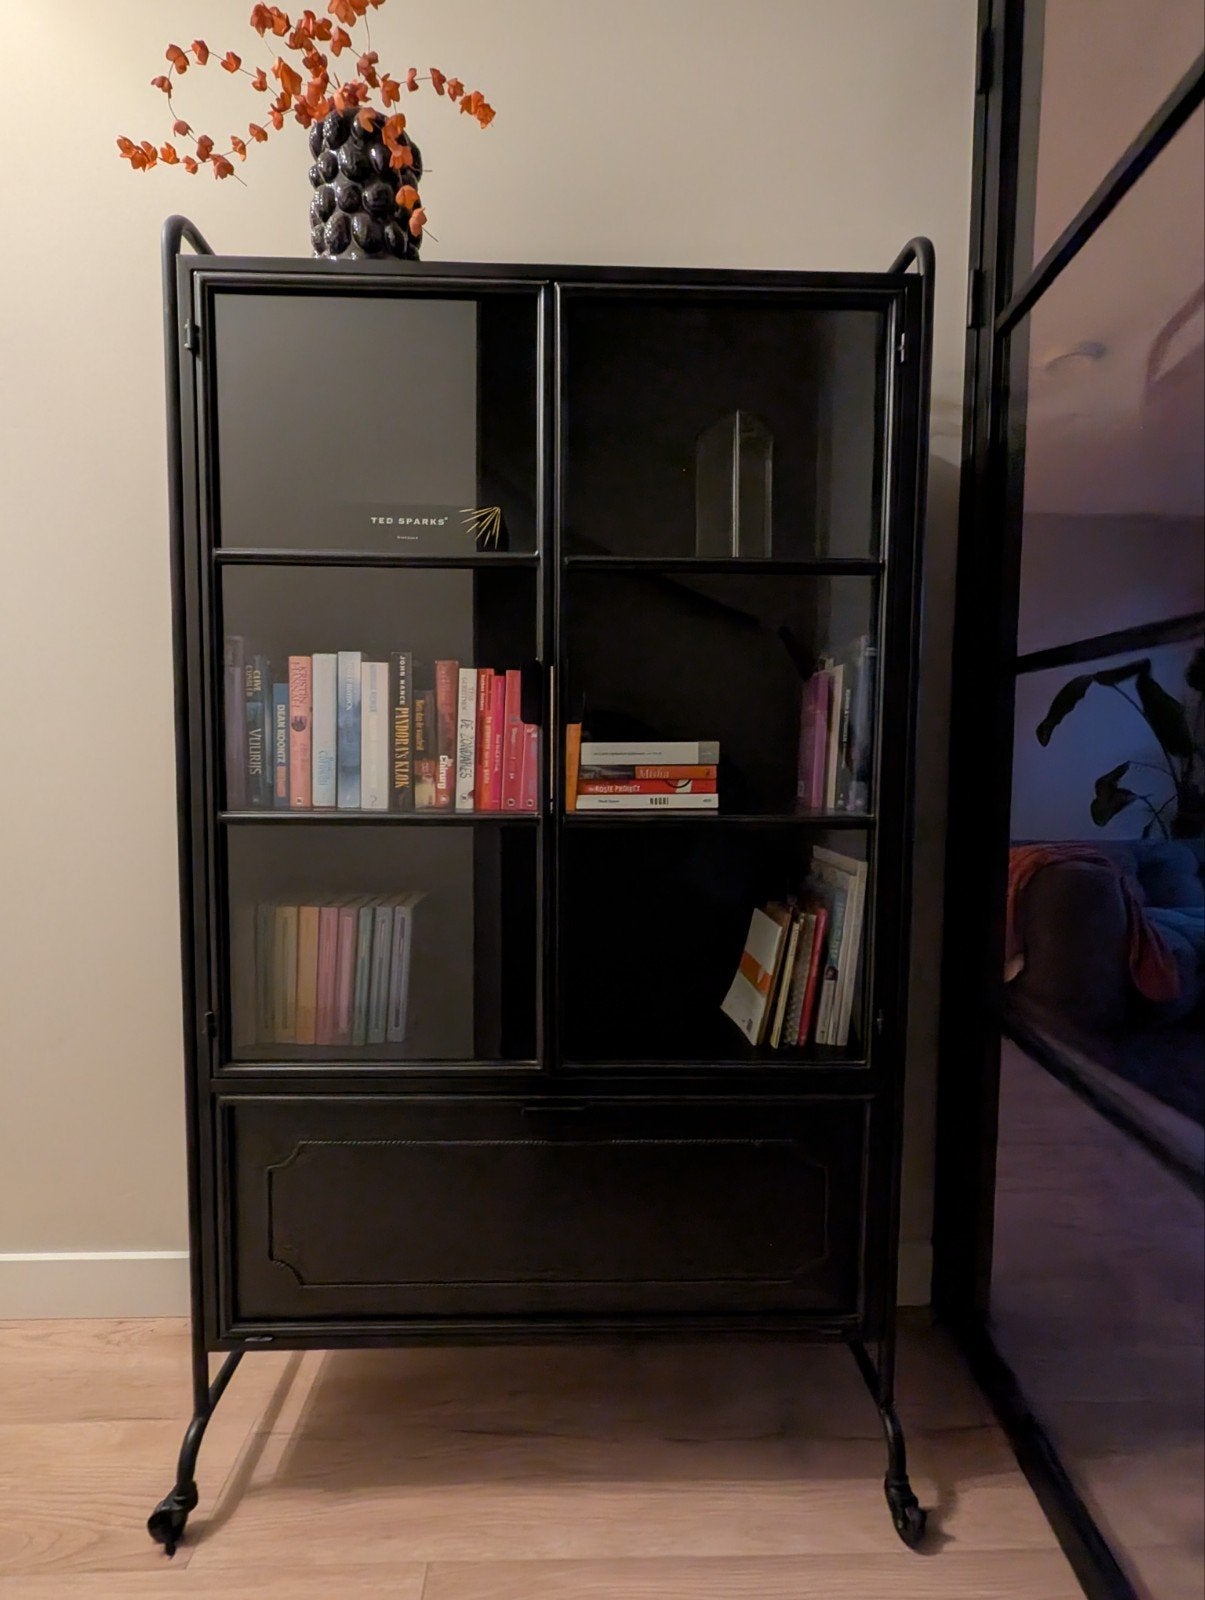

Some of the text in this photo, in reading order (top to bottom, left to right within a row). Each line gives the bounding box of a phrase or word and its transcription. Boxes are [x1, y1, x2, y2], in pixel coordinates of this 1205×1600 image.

[276, 704, 286, 728] DEAN
[460, 718, 474, 731] DE
[248, 728, 262, 775] VUURIJS
[276, 729, 286, 764] KOONTZ
[394, 760, 410, 789] KLOK
[437, 755, 449, 790] Chirurg
